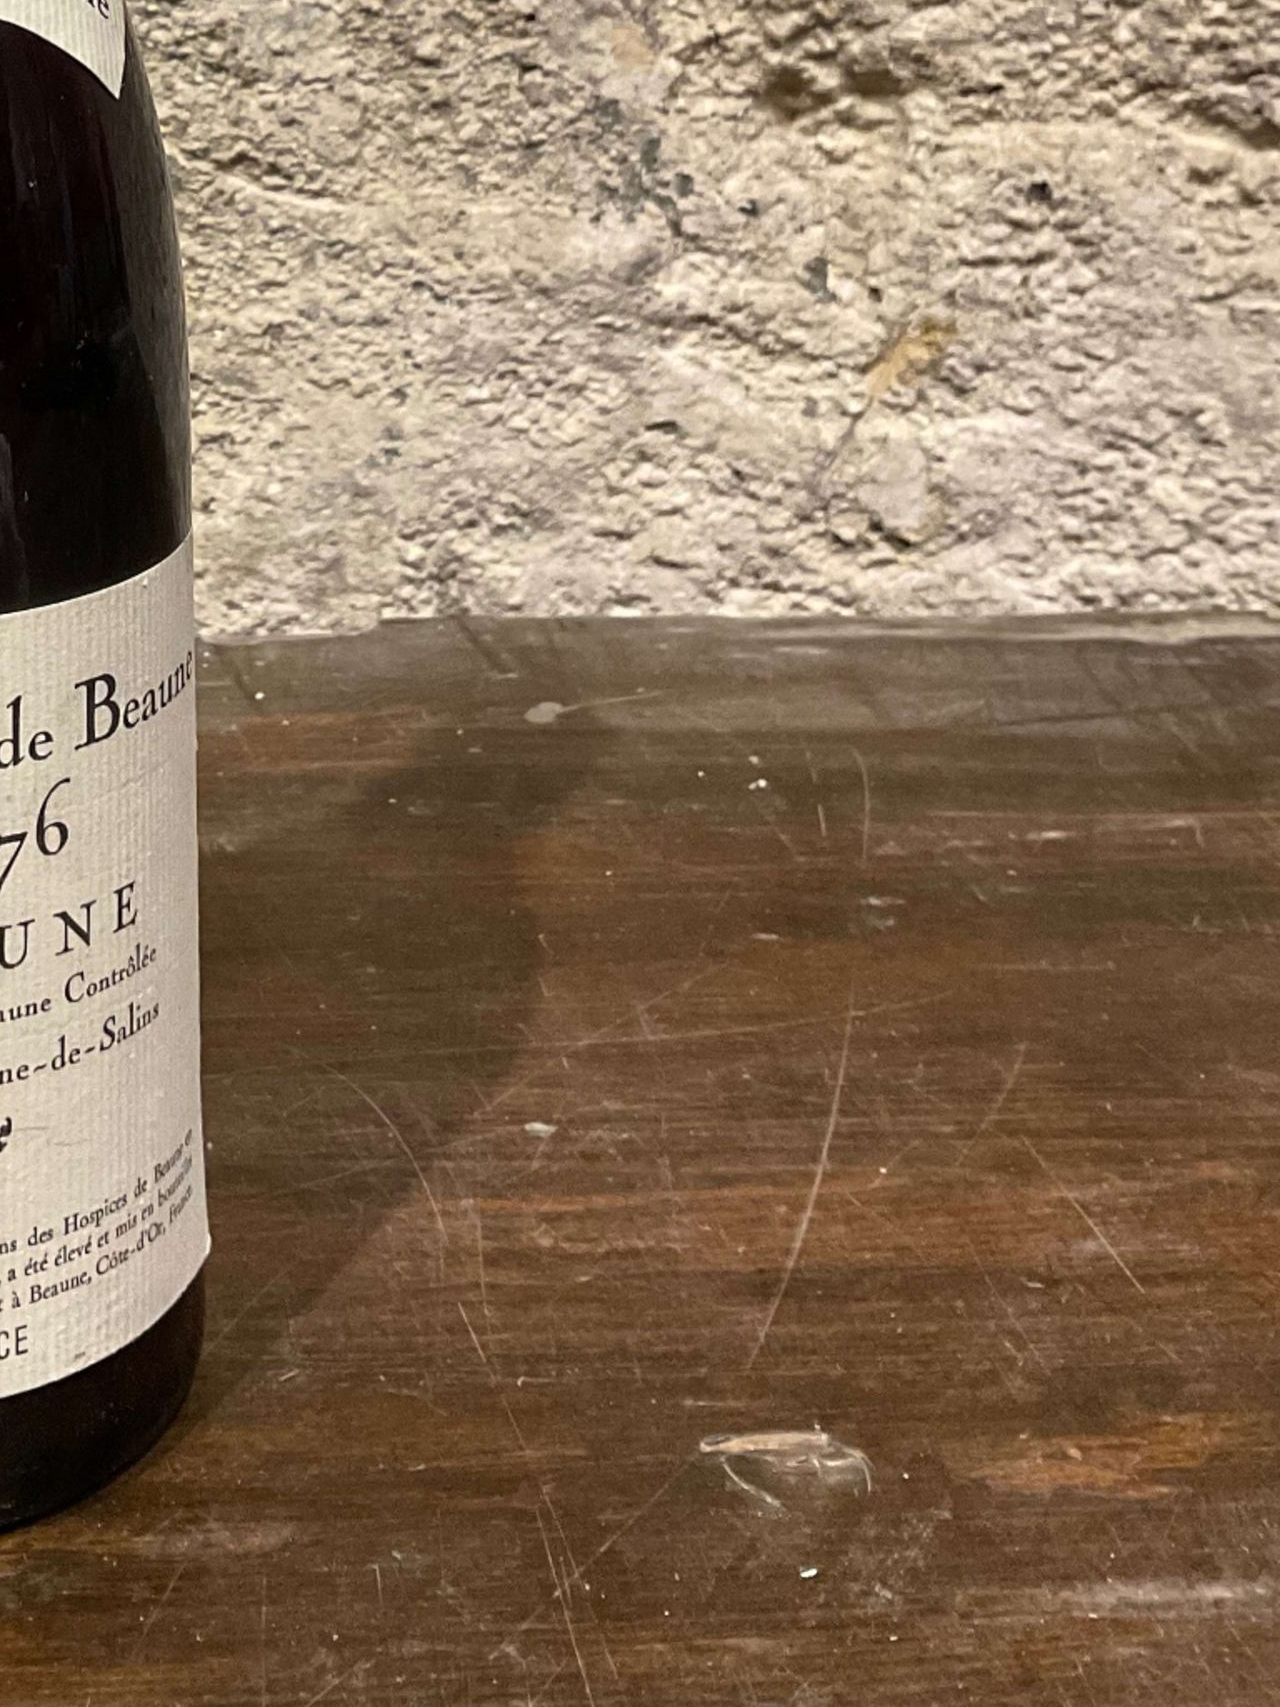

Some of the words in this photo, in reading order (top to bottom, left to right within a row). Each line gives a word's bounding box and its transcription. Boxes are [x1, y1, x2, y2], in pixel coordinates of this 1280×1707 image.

[74, 651, 192, 751] Beaune
[64, 943, 158, 1004] Contrôlée
[7, 1268, 17, 1282] a
[24, 1255, 49, 1277] été
[54, 1242, 93, 1267] élevé
[97, 1231, 109, 1248] et
[115, 1212, 138, 1238] mis
[27, 1226, 54, 1247] des
[63, 1193, 128, 1236] Hospices
[134, 1177, 148, 1198] de
[11, 1291, 21, 1309] à
[28, 1269, 93, 1305] Beaune,
